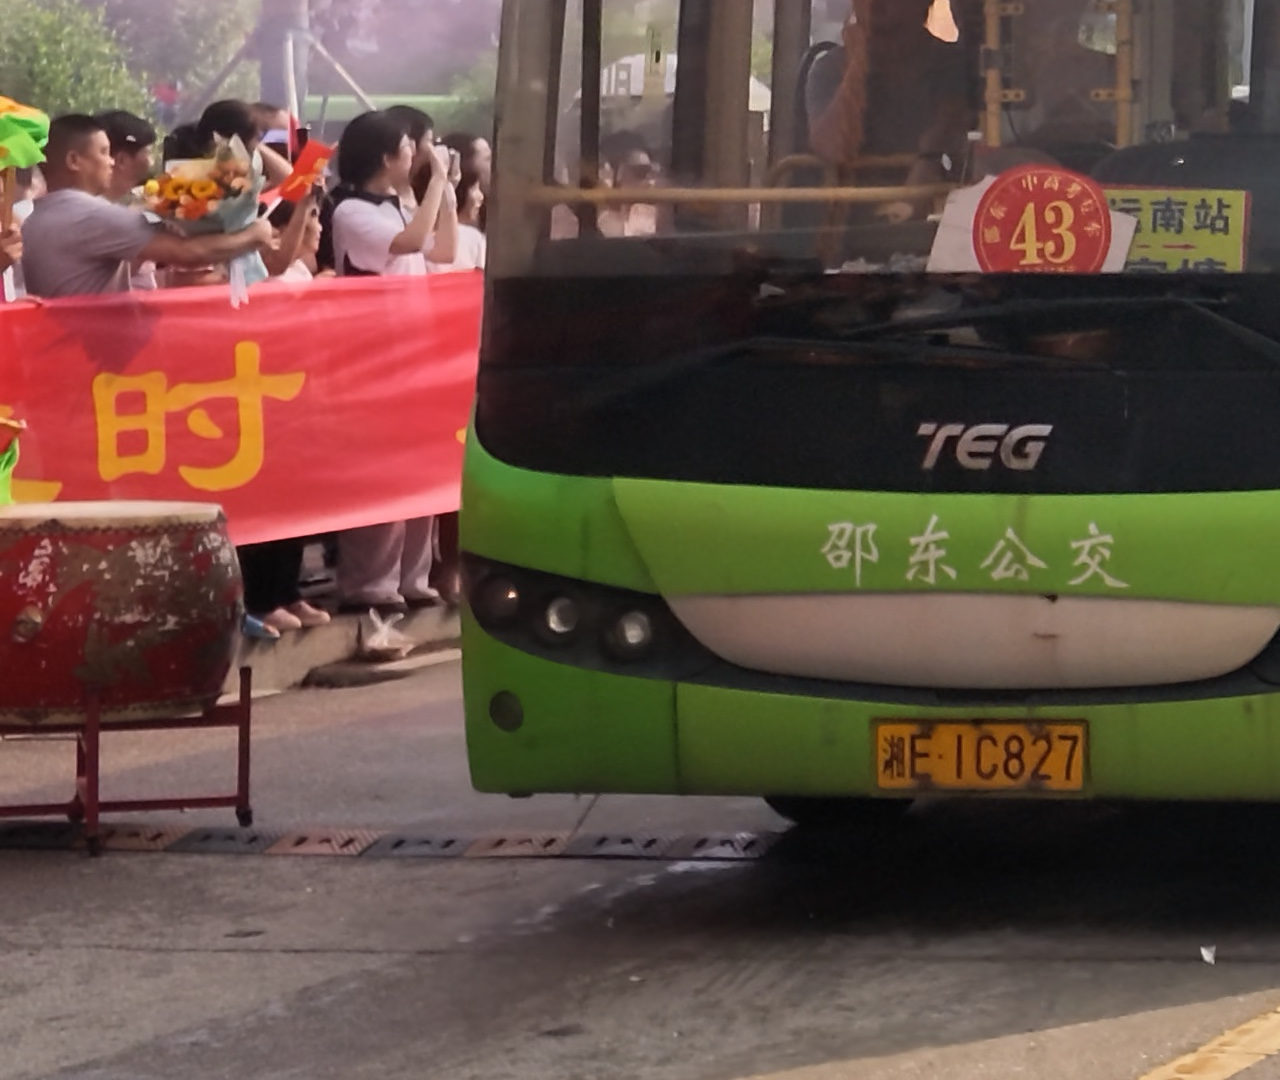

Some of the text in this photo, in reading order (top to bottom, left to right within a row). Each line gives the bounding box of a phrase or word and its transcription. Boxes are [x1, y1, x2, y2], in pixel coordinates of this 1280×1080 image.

[1008, 200, 1077, 265] 43
[916, 422, 1054, 471] TEG
[819, 514, 1131, 590] 邵东公交
